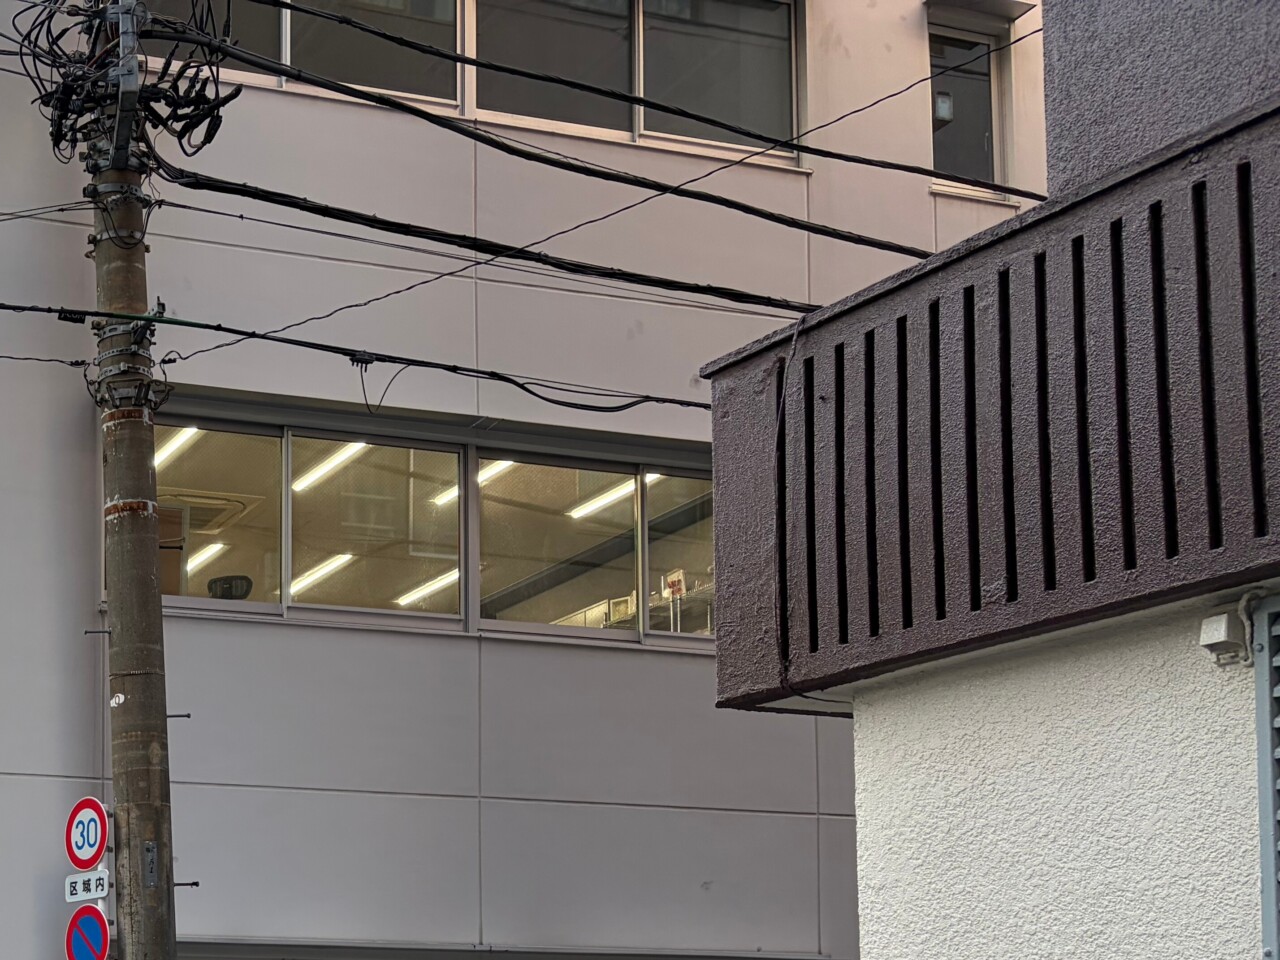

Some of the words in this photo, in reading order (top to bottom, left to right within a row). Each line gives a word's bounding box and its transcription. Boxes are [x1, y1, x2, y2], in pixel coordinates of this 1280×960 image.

[75, 817, 98, 851] 30
[70, 876, 105, 896] 区域内
